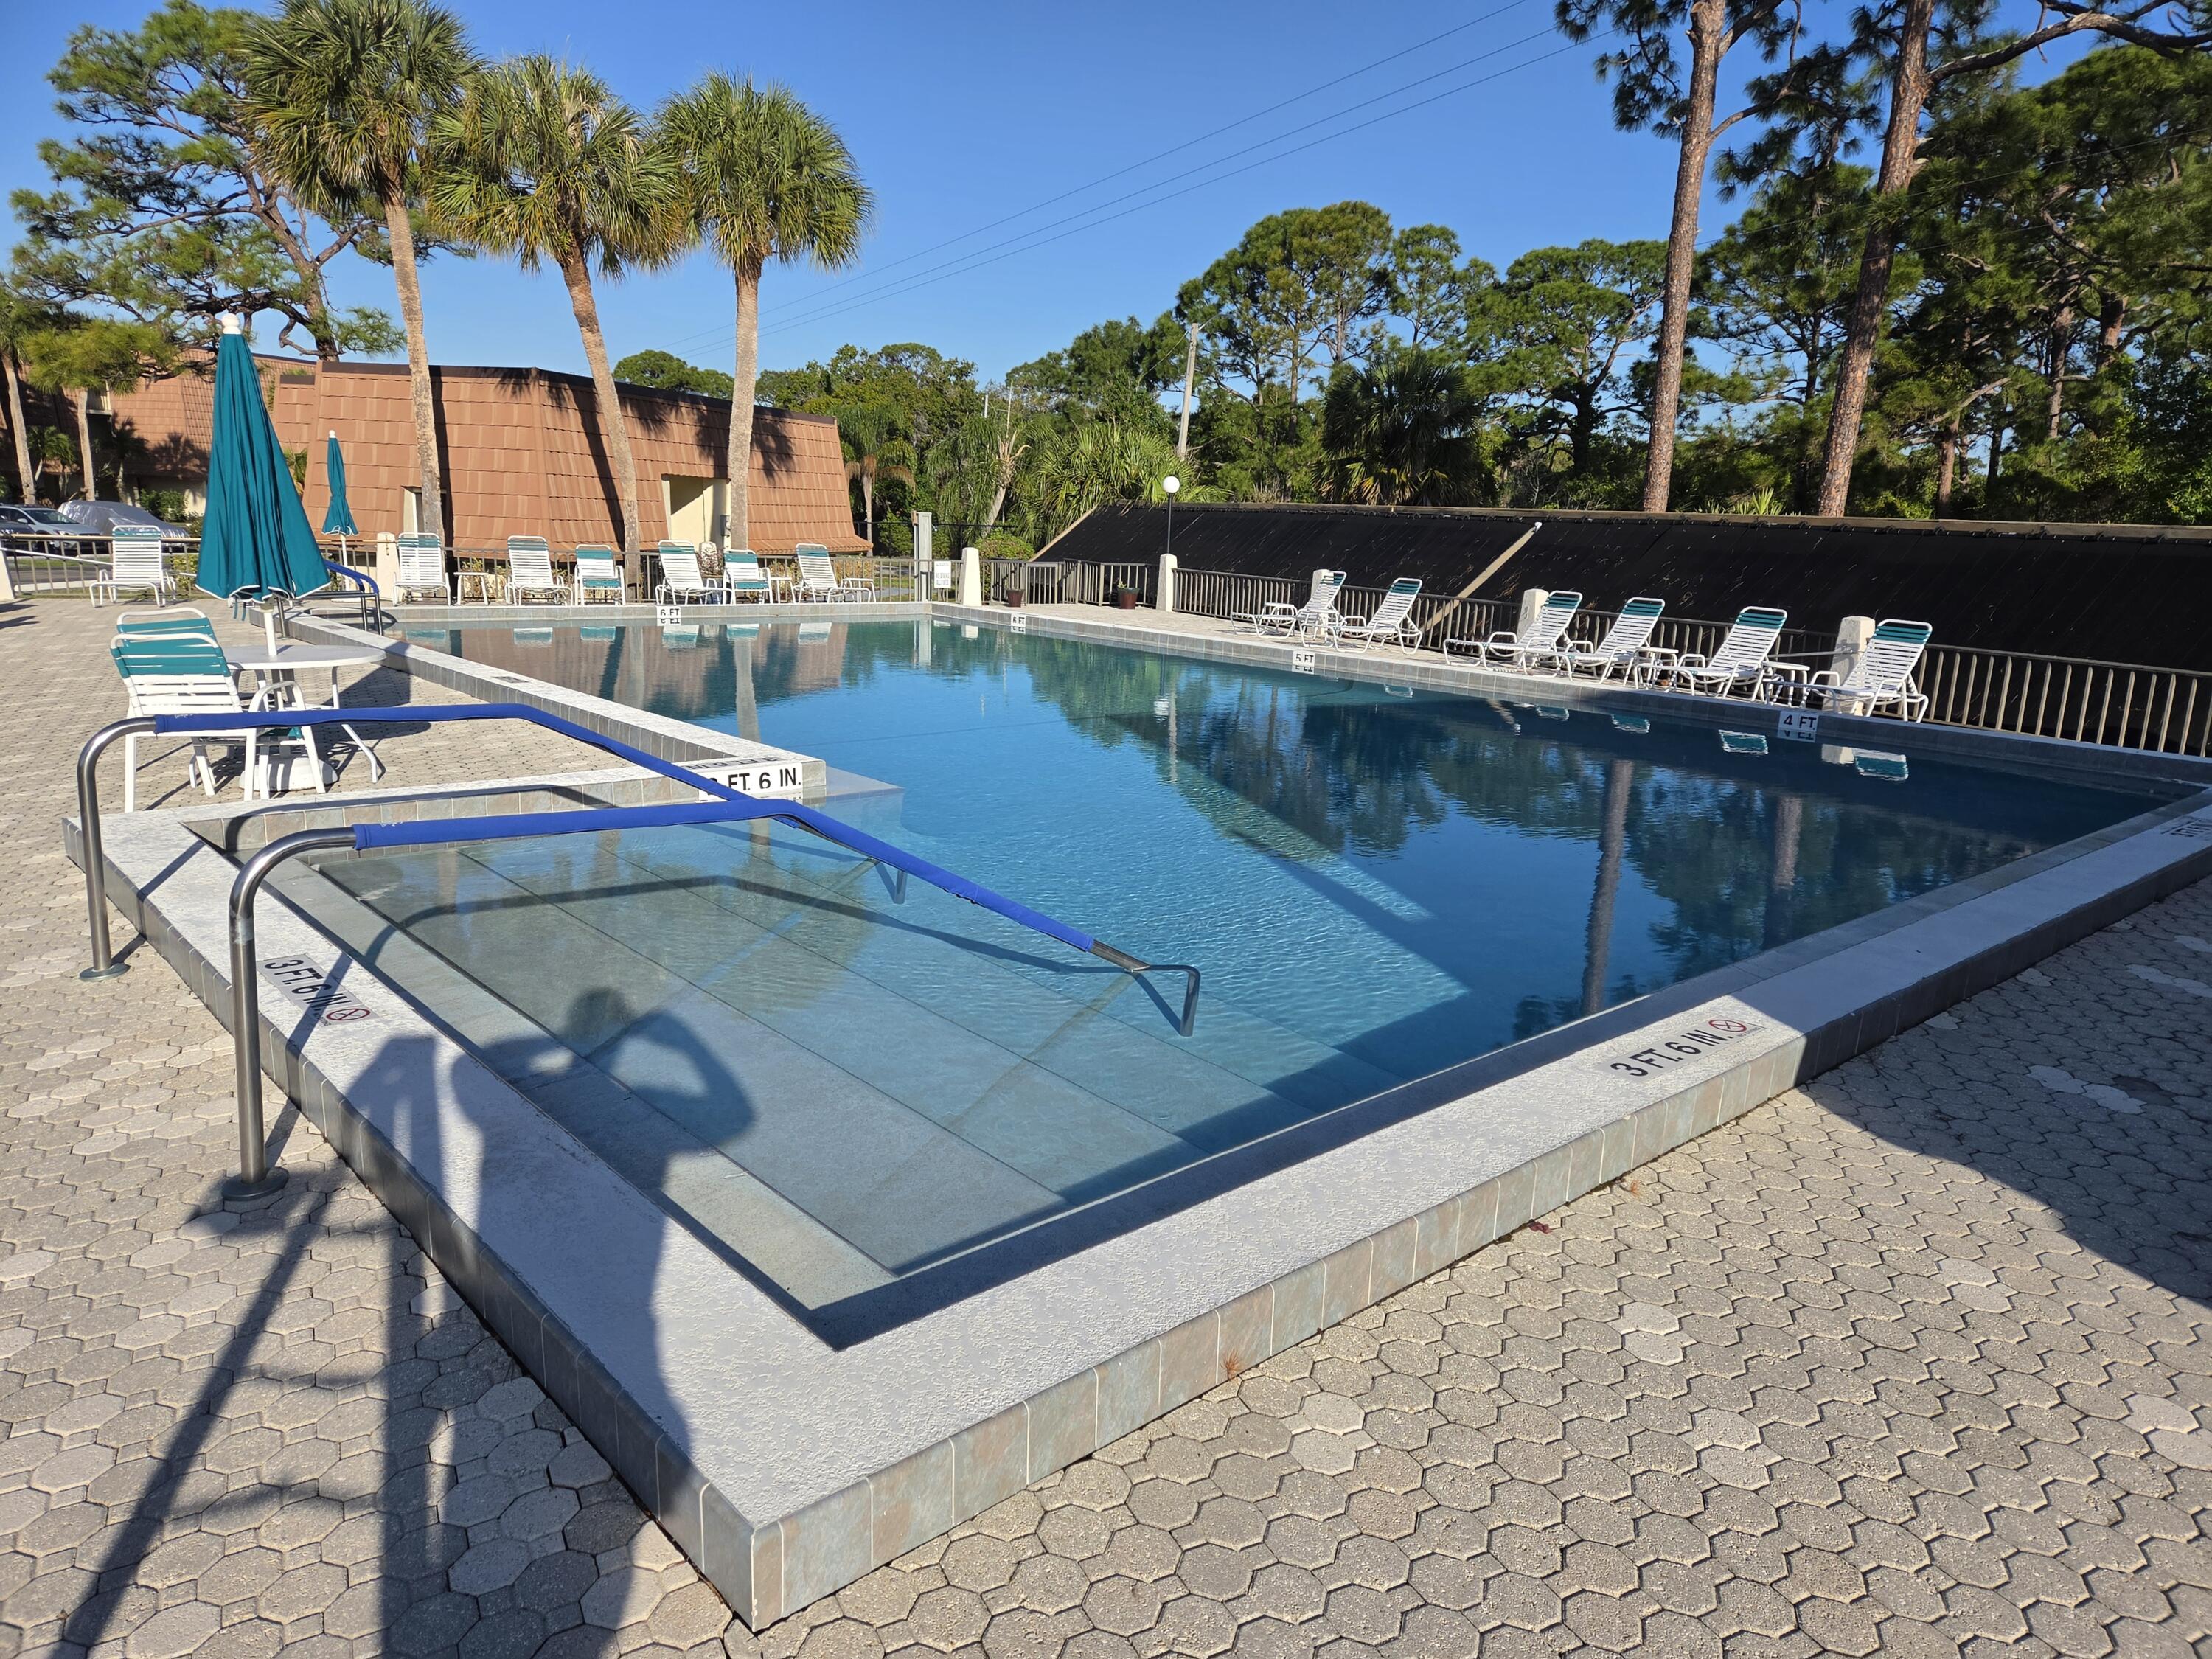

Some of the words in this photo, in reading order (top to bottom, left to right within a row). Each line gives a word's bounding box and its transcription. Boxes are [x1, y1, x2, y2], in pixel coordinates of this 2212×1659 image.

[1304, 654, 1314, 663] FT
[1783, 714, 1793, 725] 4
[728, 773, 751, 791] FT.
[759, 772, 771, 790] 6
[779, 768, 801, 787] IN.
[265, 959, 304, 970] 3
[274, 967, 324, 985] FT.
[291, 984, 333, 994] 6
[302, 993, 352, 1011] IN.
[1681, 1029, 1734, 1046] IN.
[1665, 1041, 1702, 1054] 6
[1629, 1048, 1684, 1068] FT.
[1610, 1062, 1649, 1077] 3
